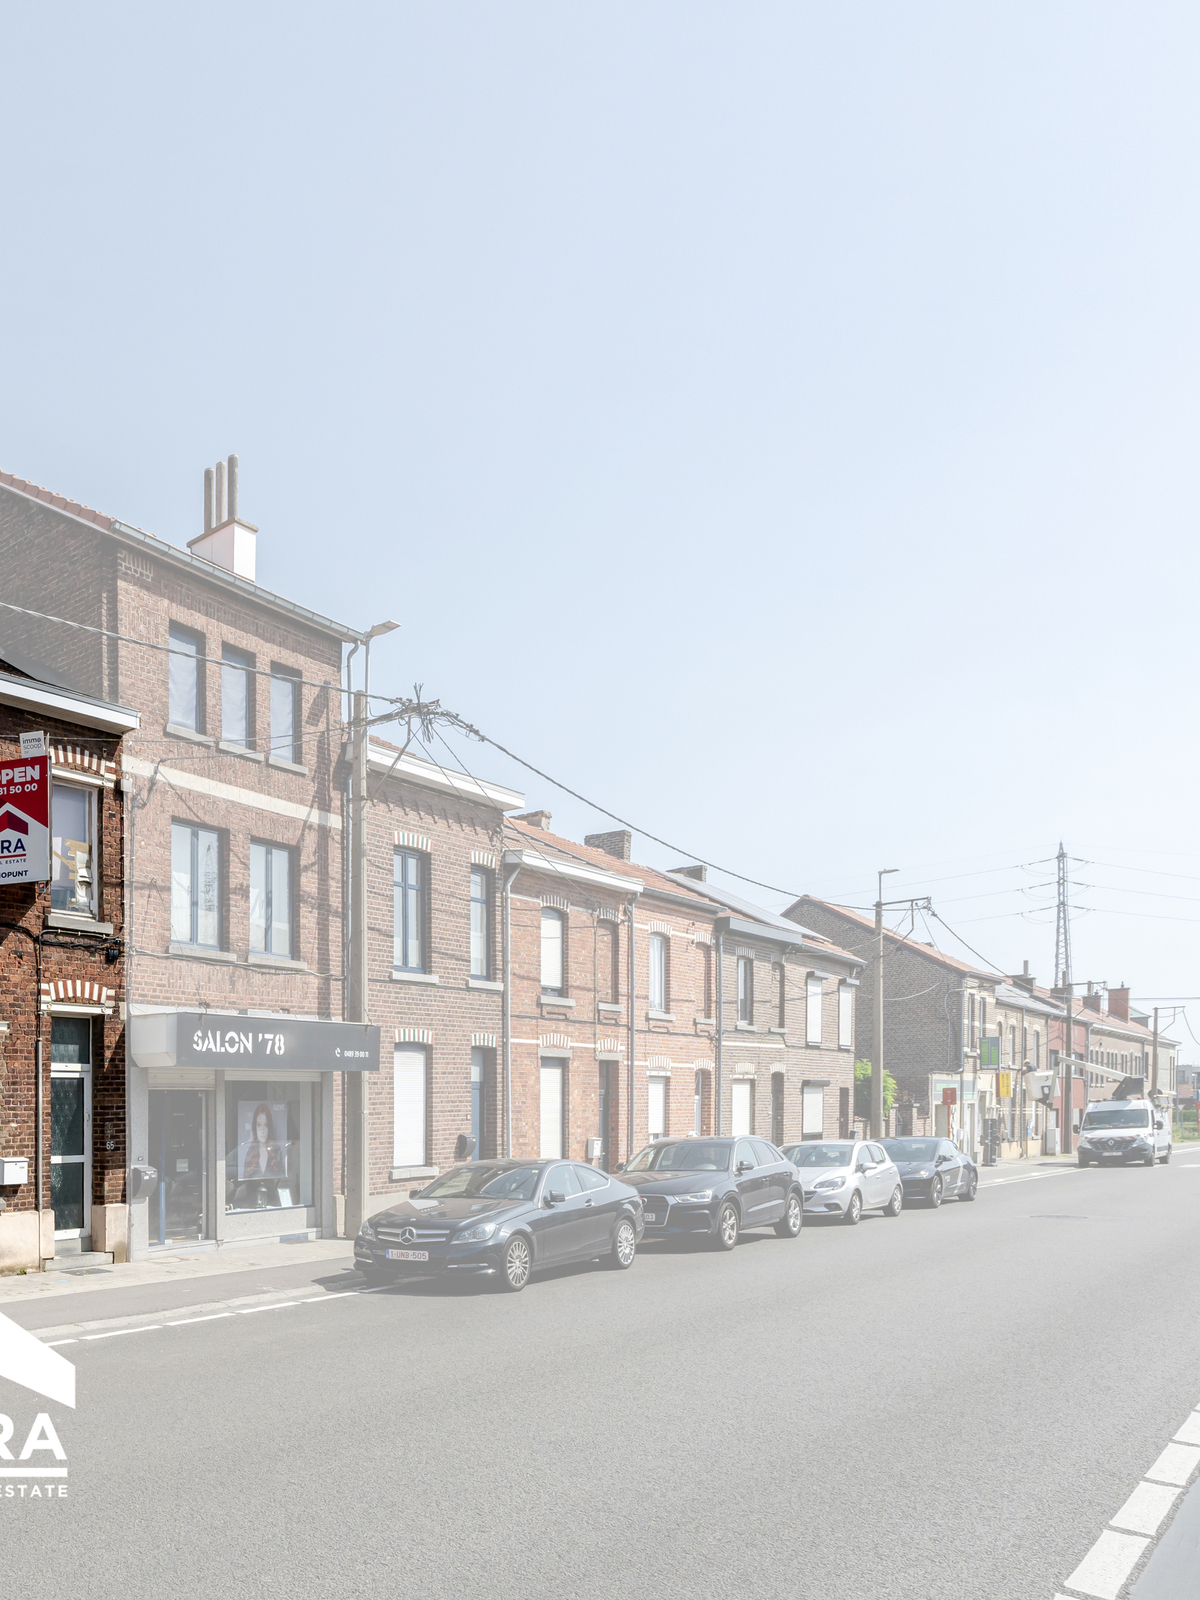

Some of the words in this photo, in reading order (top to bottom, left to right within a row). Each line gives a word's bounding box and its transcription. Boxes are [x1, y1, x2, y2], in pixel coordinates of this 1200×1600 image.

[9, 785, 22, 794] 50
[24, 783, 38, 792] 00
[192, 1029, 253, 1054] SALON
[258, 1033, 285, 1056] '78
[106, 1140, 115, 1150] 65
[390, 1250, 427, 1260] 1-UNB-505
